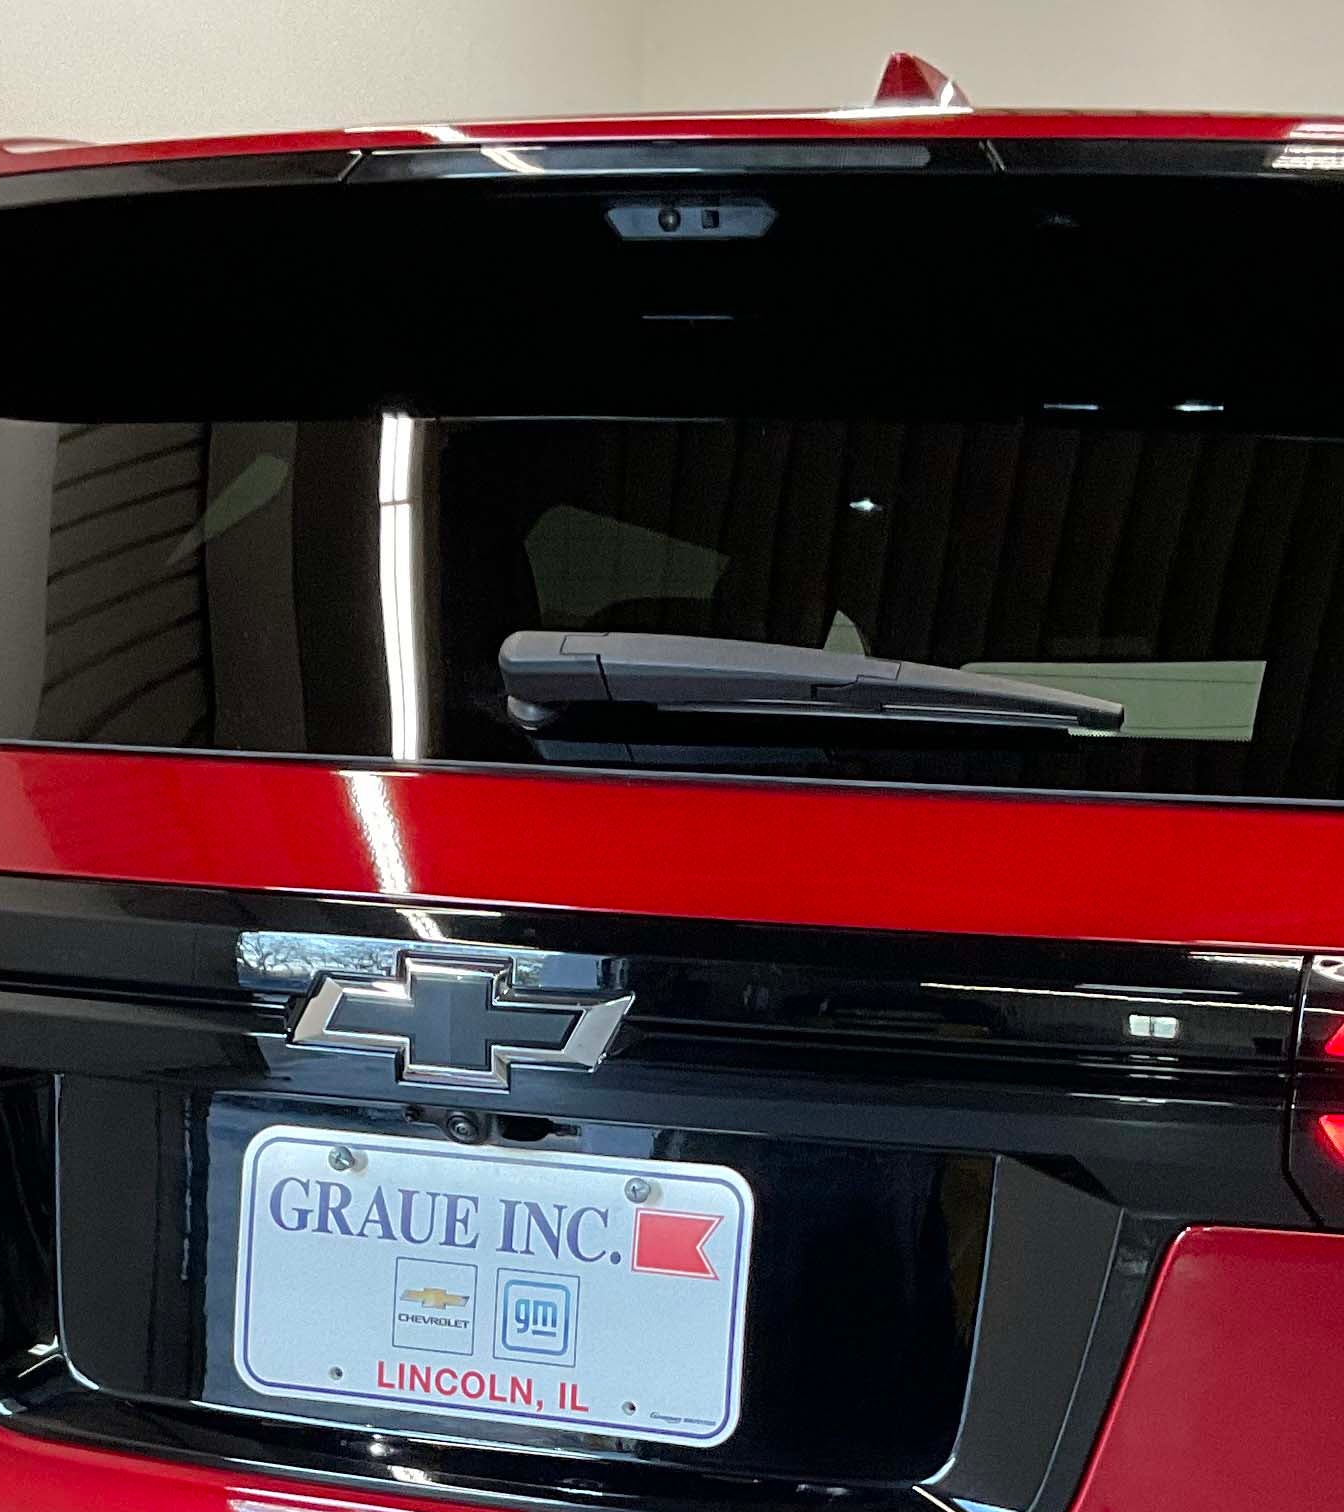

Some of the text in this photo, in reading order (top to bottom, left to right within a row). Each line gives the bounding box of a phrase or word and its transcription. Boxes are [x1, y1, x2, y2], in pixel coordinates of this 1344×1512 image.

[269, 1176, 622, 1266] GRAUE INC.
[397, 1312, 470, 1330] CHEVROLET
[514, 1299, 558, 1338] gm
[376, 1360, 589, 1413] LINCOLN, IL
